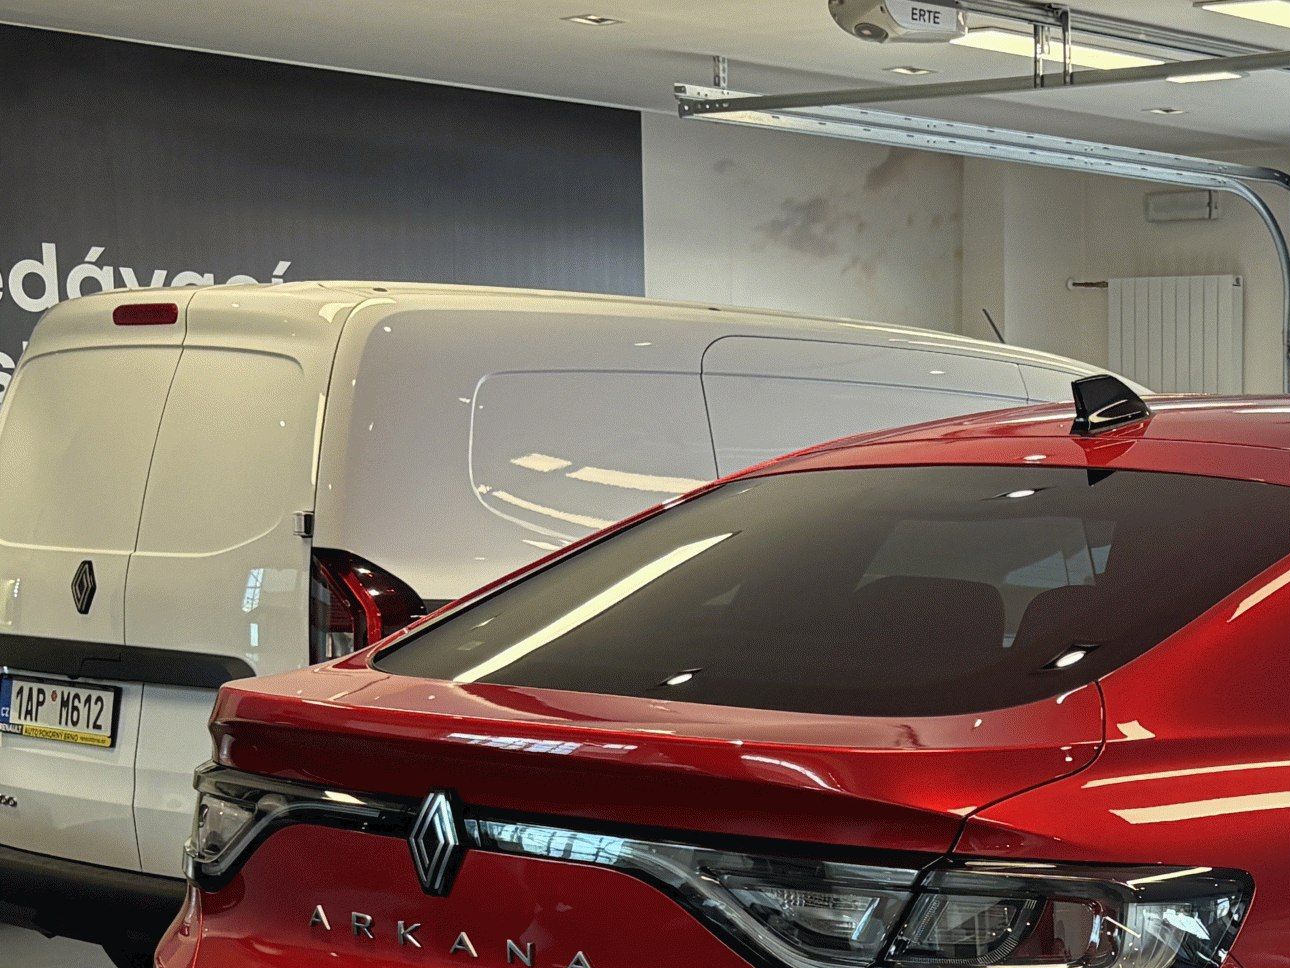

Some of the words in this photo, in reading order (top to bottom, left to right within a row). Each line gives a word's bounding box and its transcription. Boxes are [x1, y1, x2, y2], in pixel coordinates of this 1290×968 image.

[911, 8, 941, 25] ERTE
[1, 706, 10, 718] CZ
[16, 685, 46, 722] 1AP
[58, 689, 104, 730] M612
